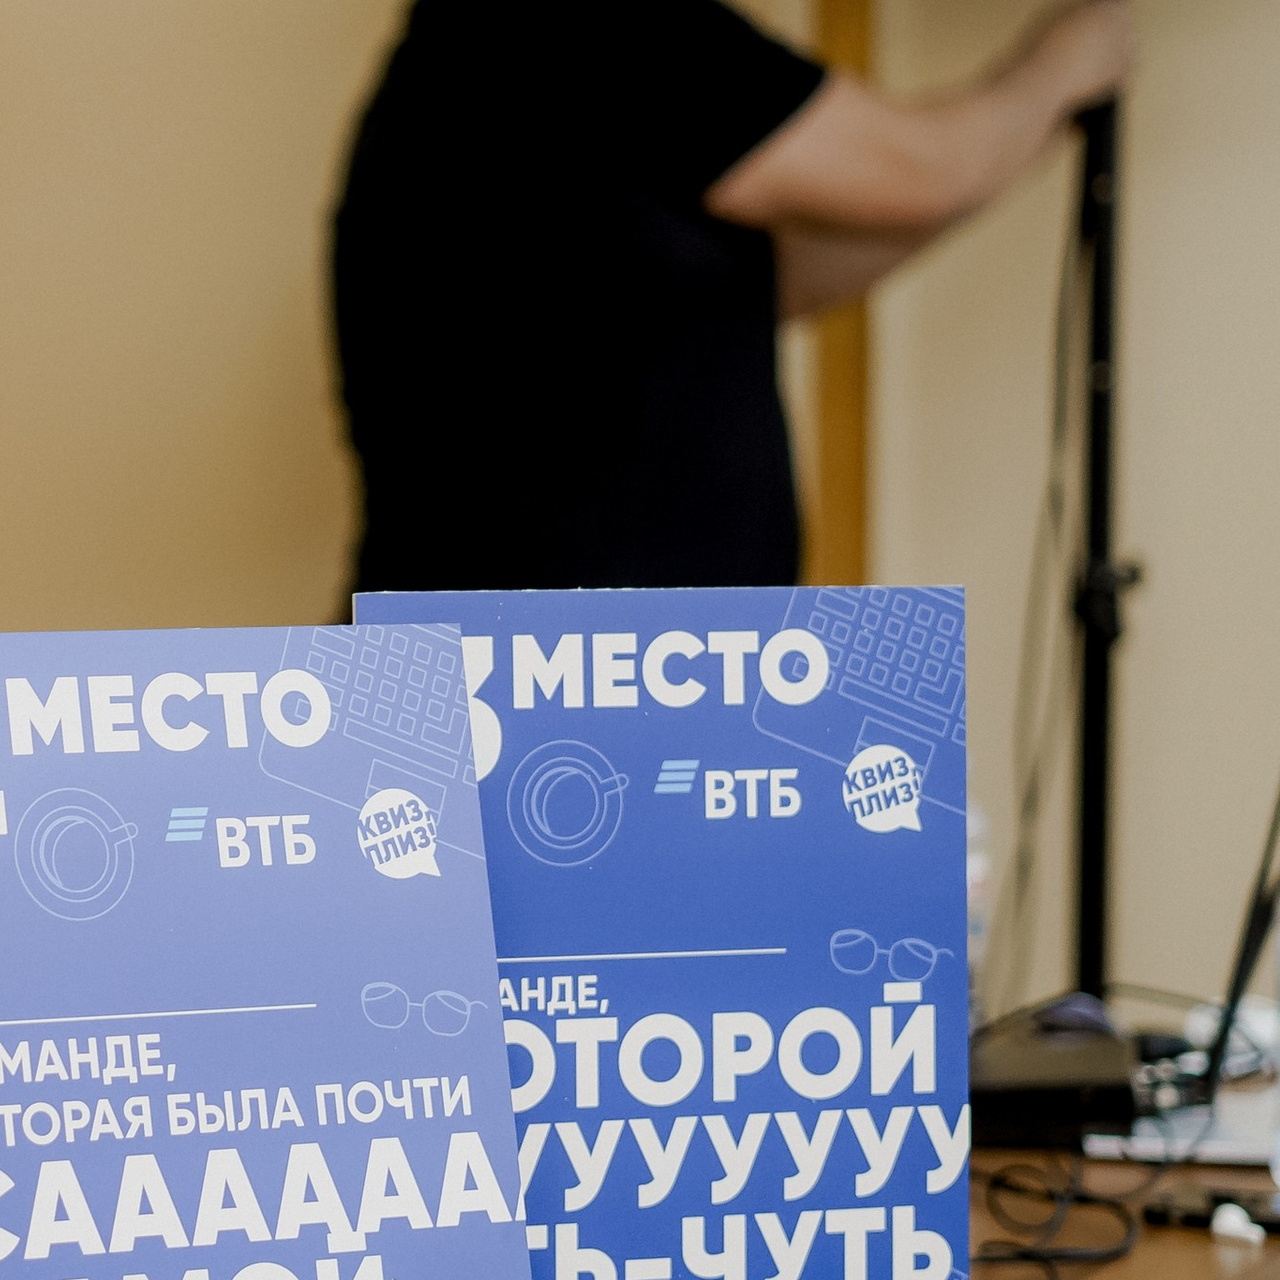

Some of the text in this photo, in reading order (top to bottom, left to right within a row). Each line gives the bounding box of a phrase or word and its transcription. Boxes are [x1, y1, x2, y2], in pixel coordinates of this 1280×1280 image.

[512, 628, 831, 710] МЕСТО
[5, 668, 331, 756] МЕСТО
[705, 768, 802, 819] ВТБ
[215, 814, 317, 868] ВТБ
[167, 1086, 304, 1136] БЫЛА
[315, 1075, 473, 1127] ПОЧТИ
